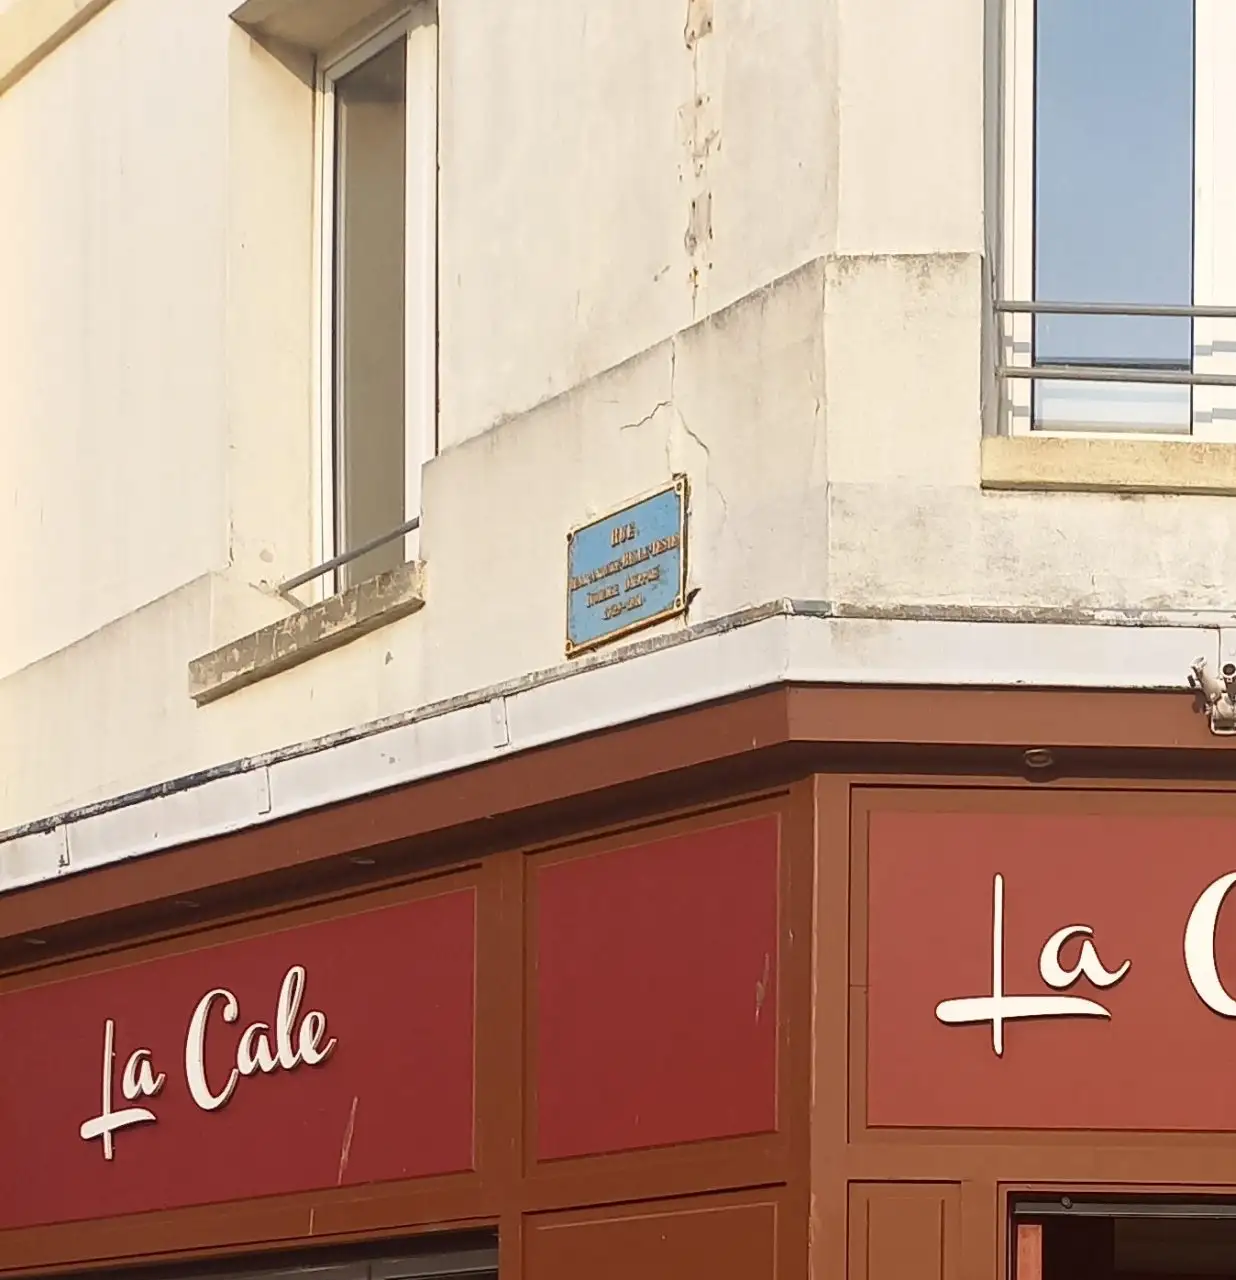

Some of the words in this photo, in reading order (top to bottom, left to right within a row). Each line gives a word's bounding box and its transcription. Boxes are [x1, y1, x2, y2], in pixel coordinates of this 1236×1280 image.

[935, 873, 1131, 1057] La
[80, 1019, 165, 1160] La
[186, 965, 337, 1110] Cale
